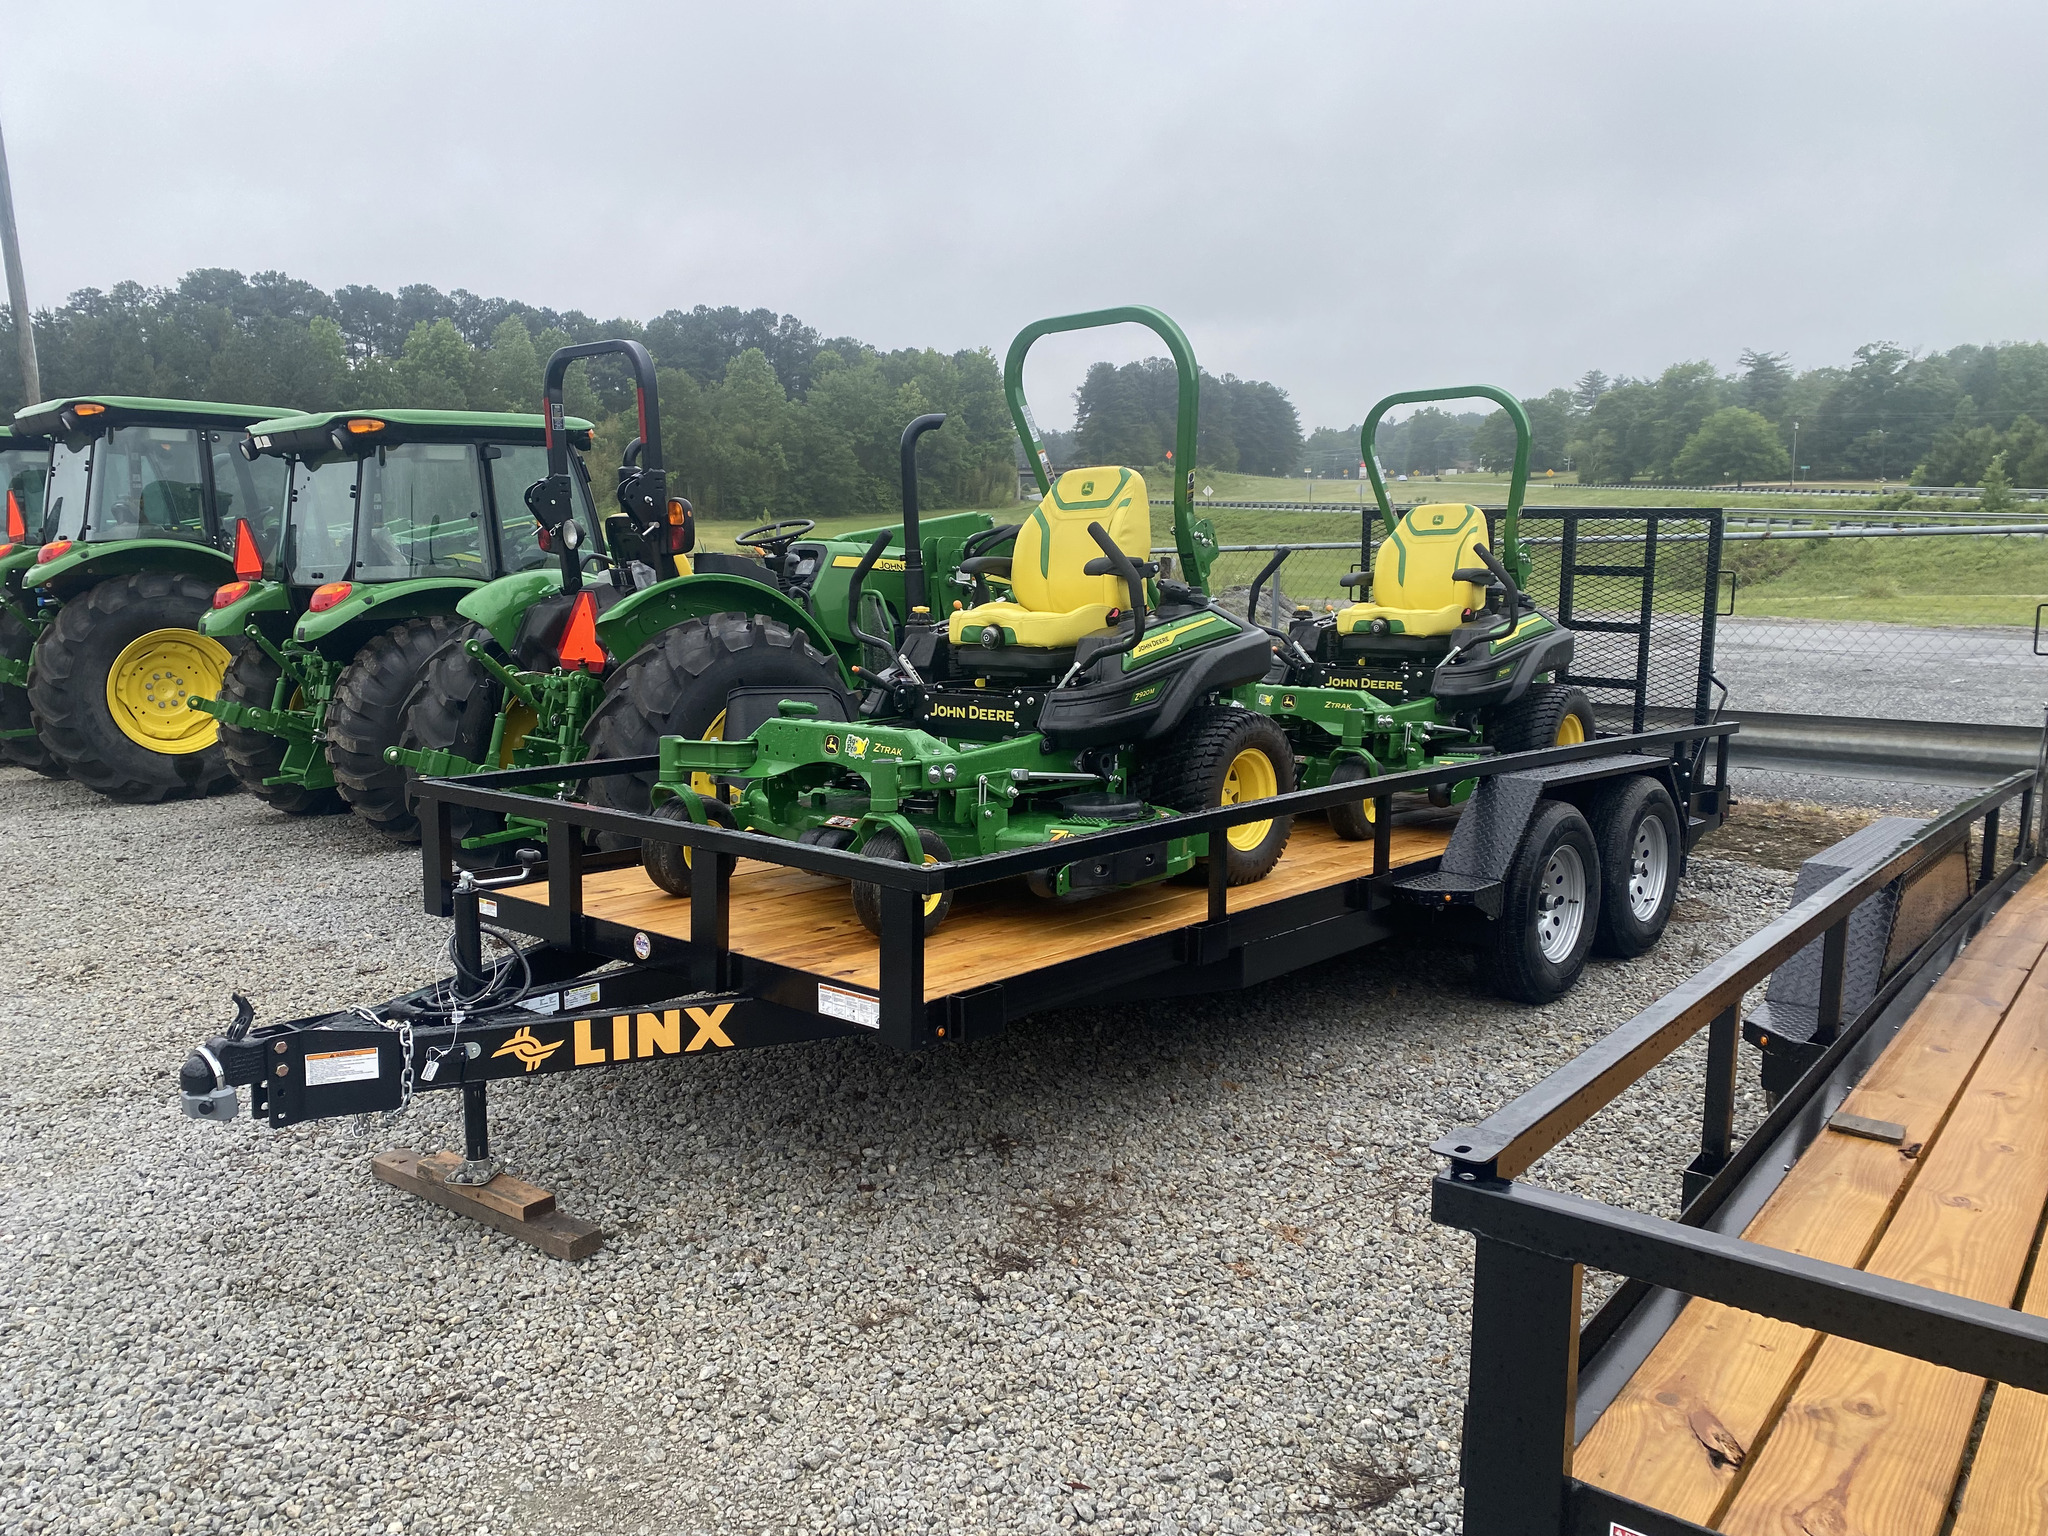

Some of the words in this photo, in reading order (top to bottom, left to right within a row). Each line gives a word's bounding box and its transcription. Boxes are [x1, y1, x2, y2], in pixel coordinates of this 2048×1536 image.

[879, 561, 903, 570] JOHN
[1138, 643, 1153, 652] JOHN
[1152, 636, 1170, 647] DEERE
[1325, 676, 1359, 689] JOHN
[1361, 677, 1403, 691] DEERE
[930, 702, 966, 719] JOHN
[968, 705, 1015, 722] DEERE
[872, 743, 904, 756] ZTRAK
[573, 1003, 735, 1066] LINX
